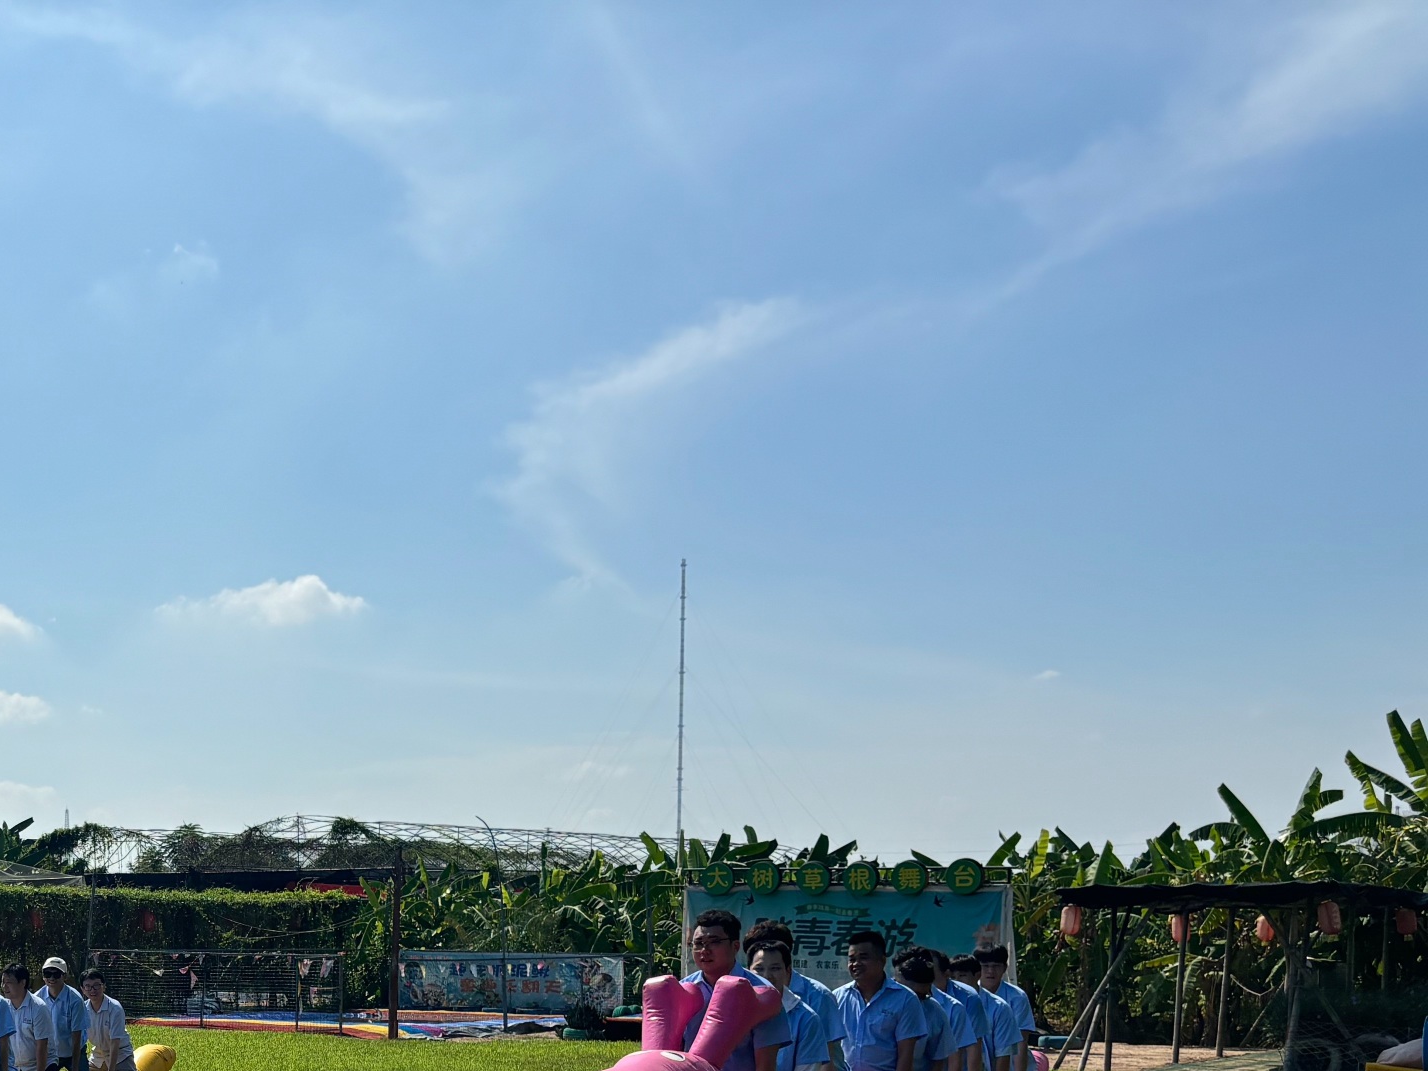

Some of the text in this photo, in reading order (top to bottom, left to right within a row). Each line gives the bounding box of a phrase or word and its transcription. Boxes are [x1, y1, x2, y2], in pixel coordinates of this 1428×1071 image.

[706, 865, 975, 890] 大树草根舞台
[755, 916, 918, 957] 青春游
